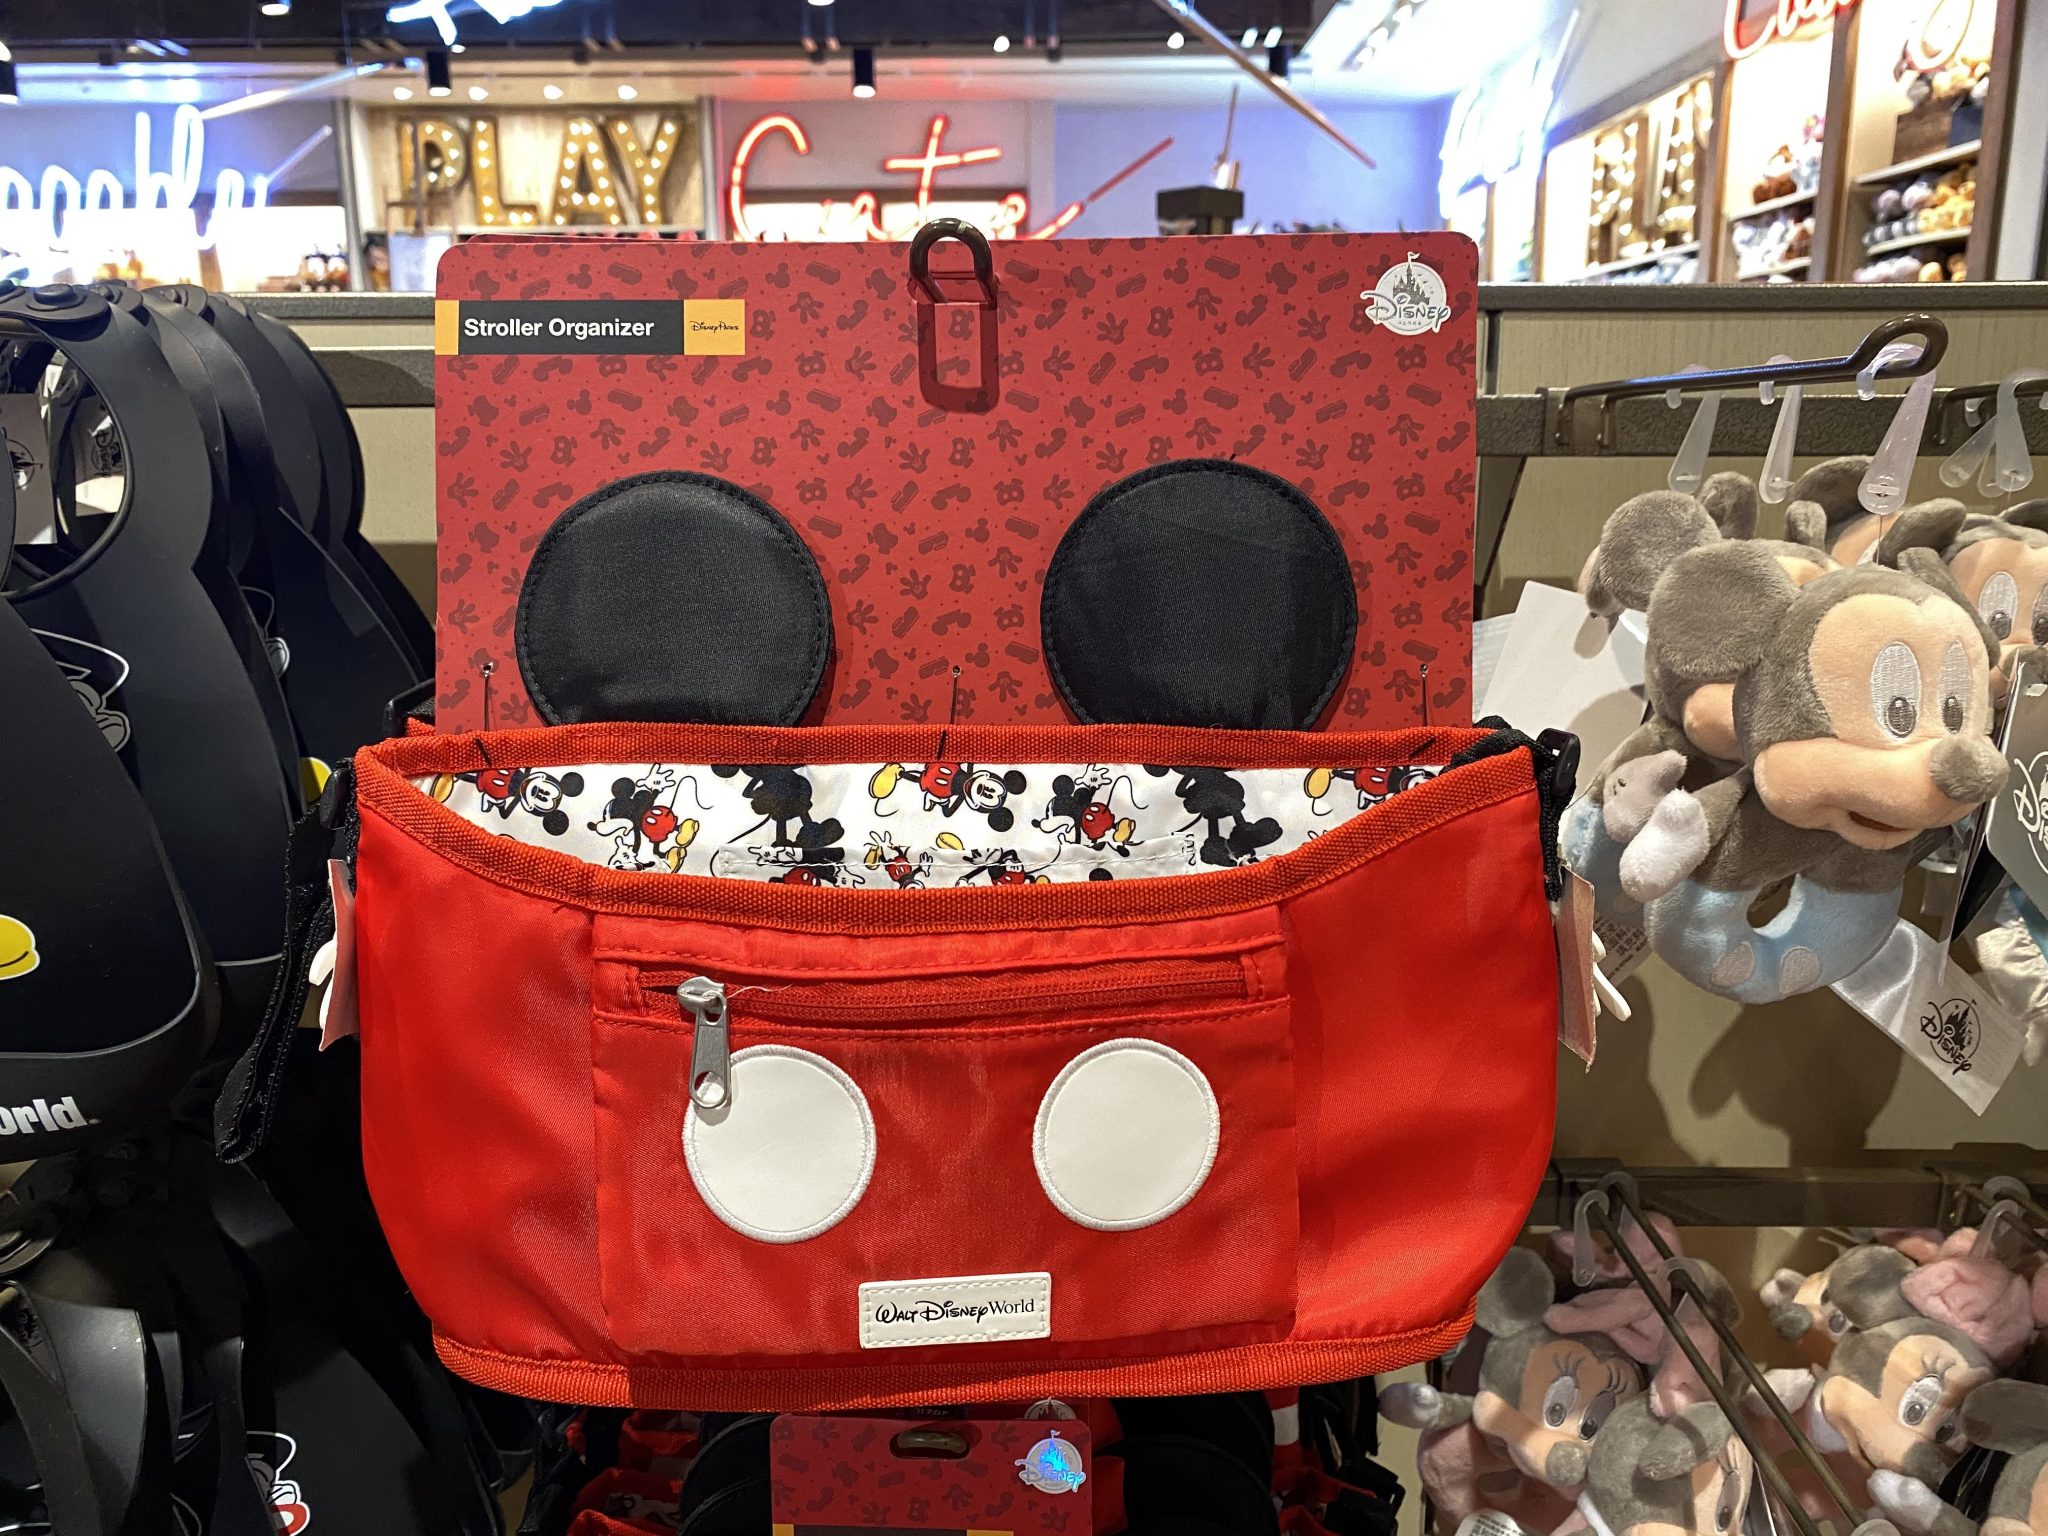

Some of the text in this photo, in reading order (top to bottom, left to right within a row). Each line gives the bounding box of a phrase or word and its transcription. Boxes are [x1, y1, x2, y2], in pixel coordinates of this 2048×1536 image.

[398, 115, 682, 226] PLAY
[464, 318, 654, 340] Stroller Organizer
[988, 1299, 1035, 1315] World
